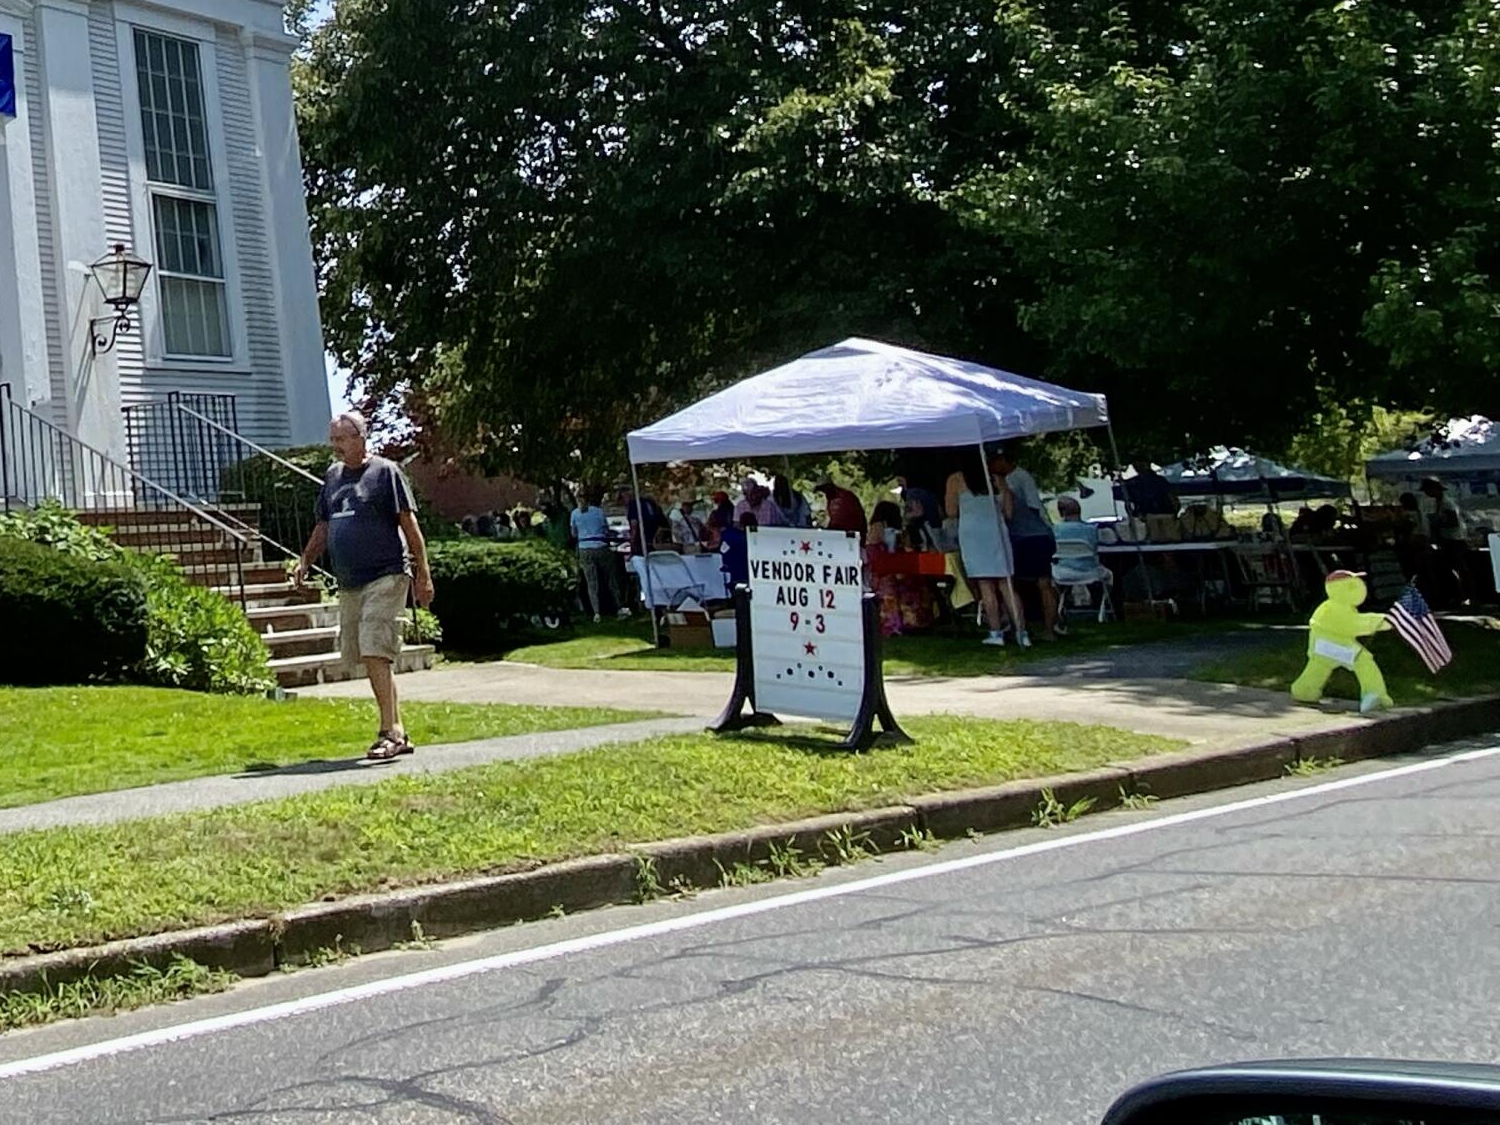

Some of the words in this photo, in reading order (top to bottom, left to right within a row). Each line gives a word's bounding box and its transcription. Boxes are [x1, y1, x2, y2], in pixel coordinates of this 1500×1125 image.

[750, 560, 815, 583] VENDOR
[822, 565, 860, 586] FAIR
[776, 586, 809, 607] AUG
[819, 588, 836, 609] 12
[789, 611, 800, 631] 9
[814, 614, 826, 634] 3
